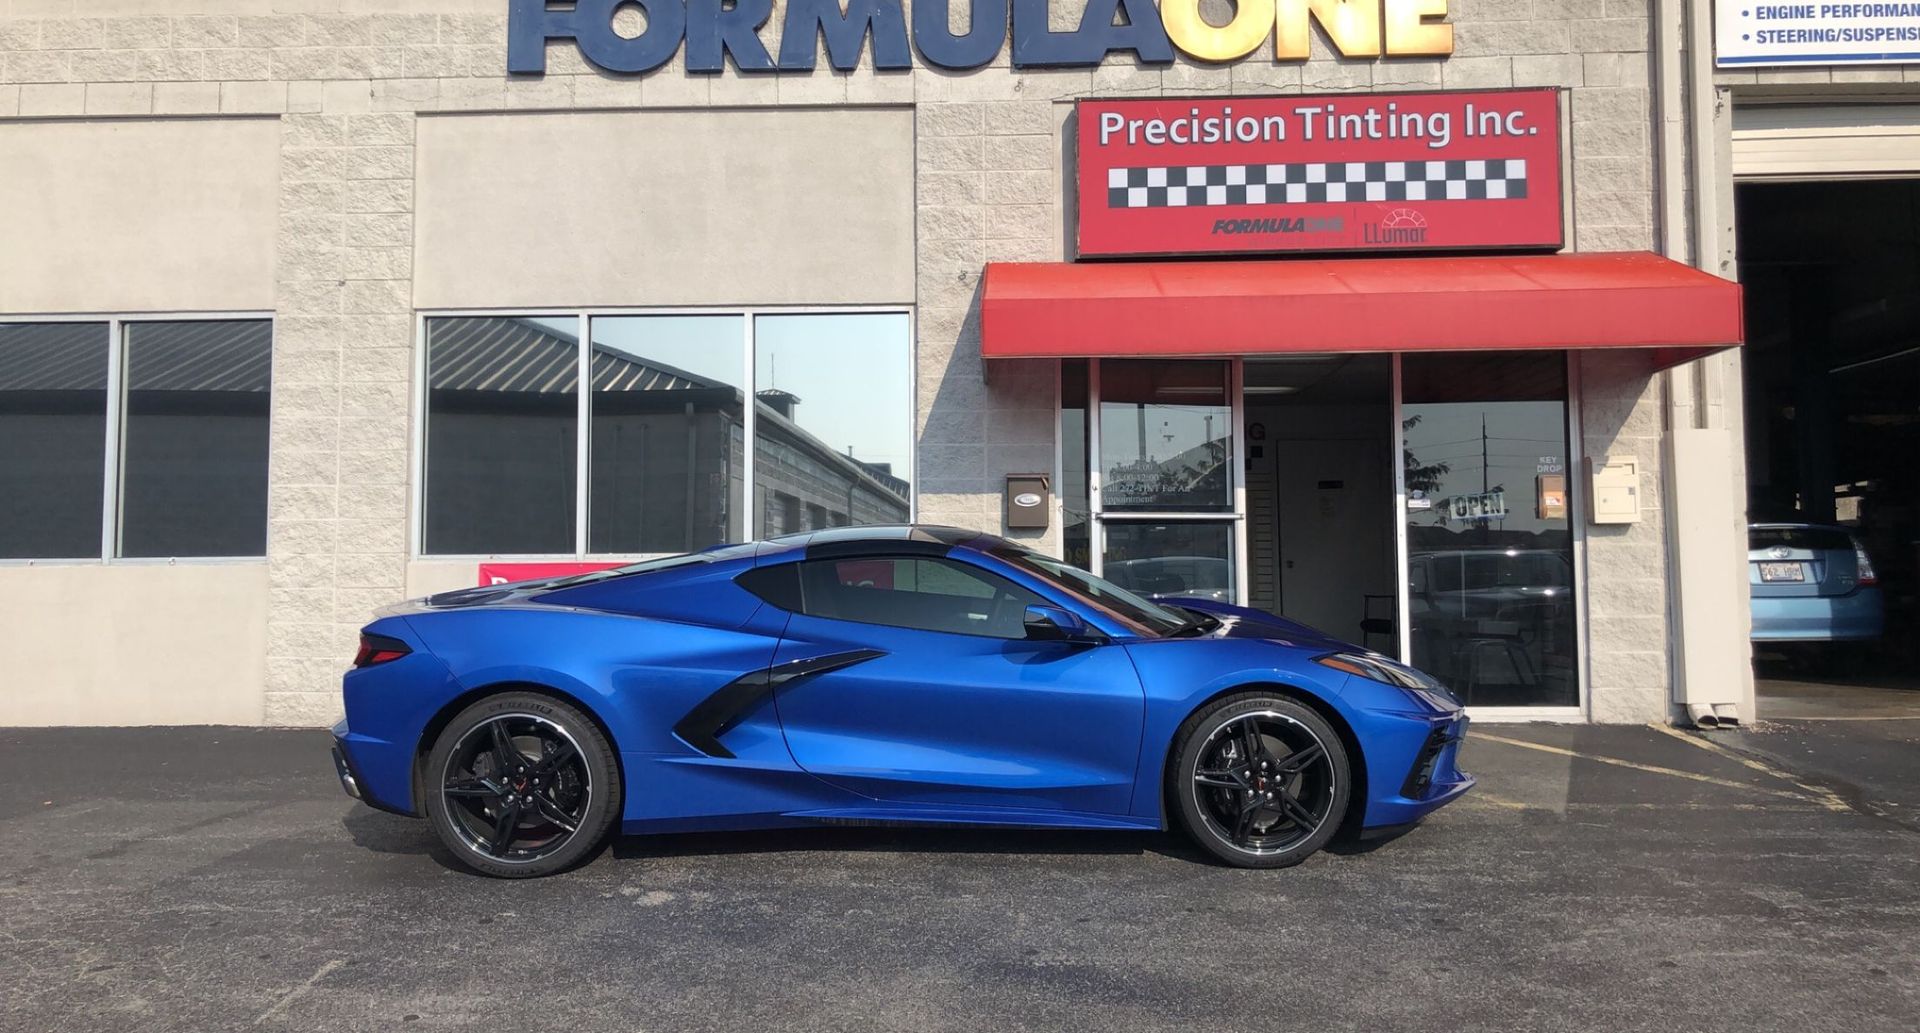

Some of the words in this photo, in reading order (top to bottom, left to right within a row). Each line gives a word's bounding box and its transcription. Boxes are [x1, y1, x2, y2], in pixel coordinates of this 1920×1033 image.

[1756, 5, 1816, 20] ENGINE
[1100, 106, 1286, 145] Precision
[1295, 103, 1451, 148] Tinting
[1465, 103, 1538, 138] Inc.
[1539, 456, 1557, 464] KEY
[1537, 464, 1562, 473] DROP
[1455, 494, 1503, 517] OPEN
